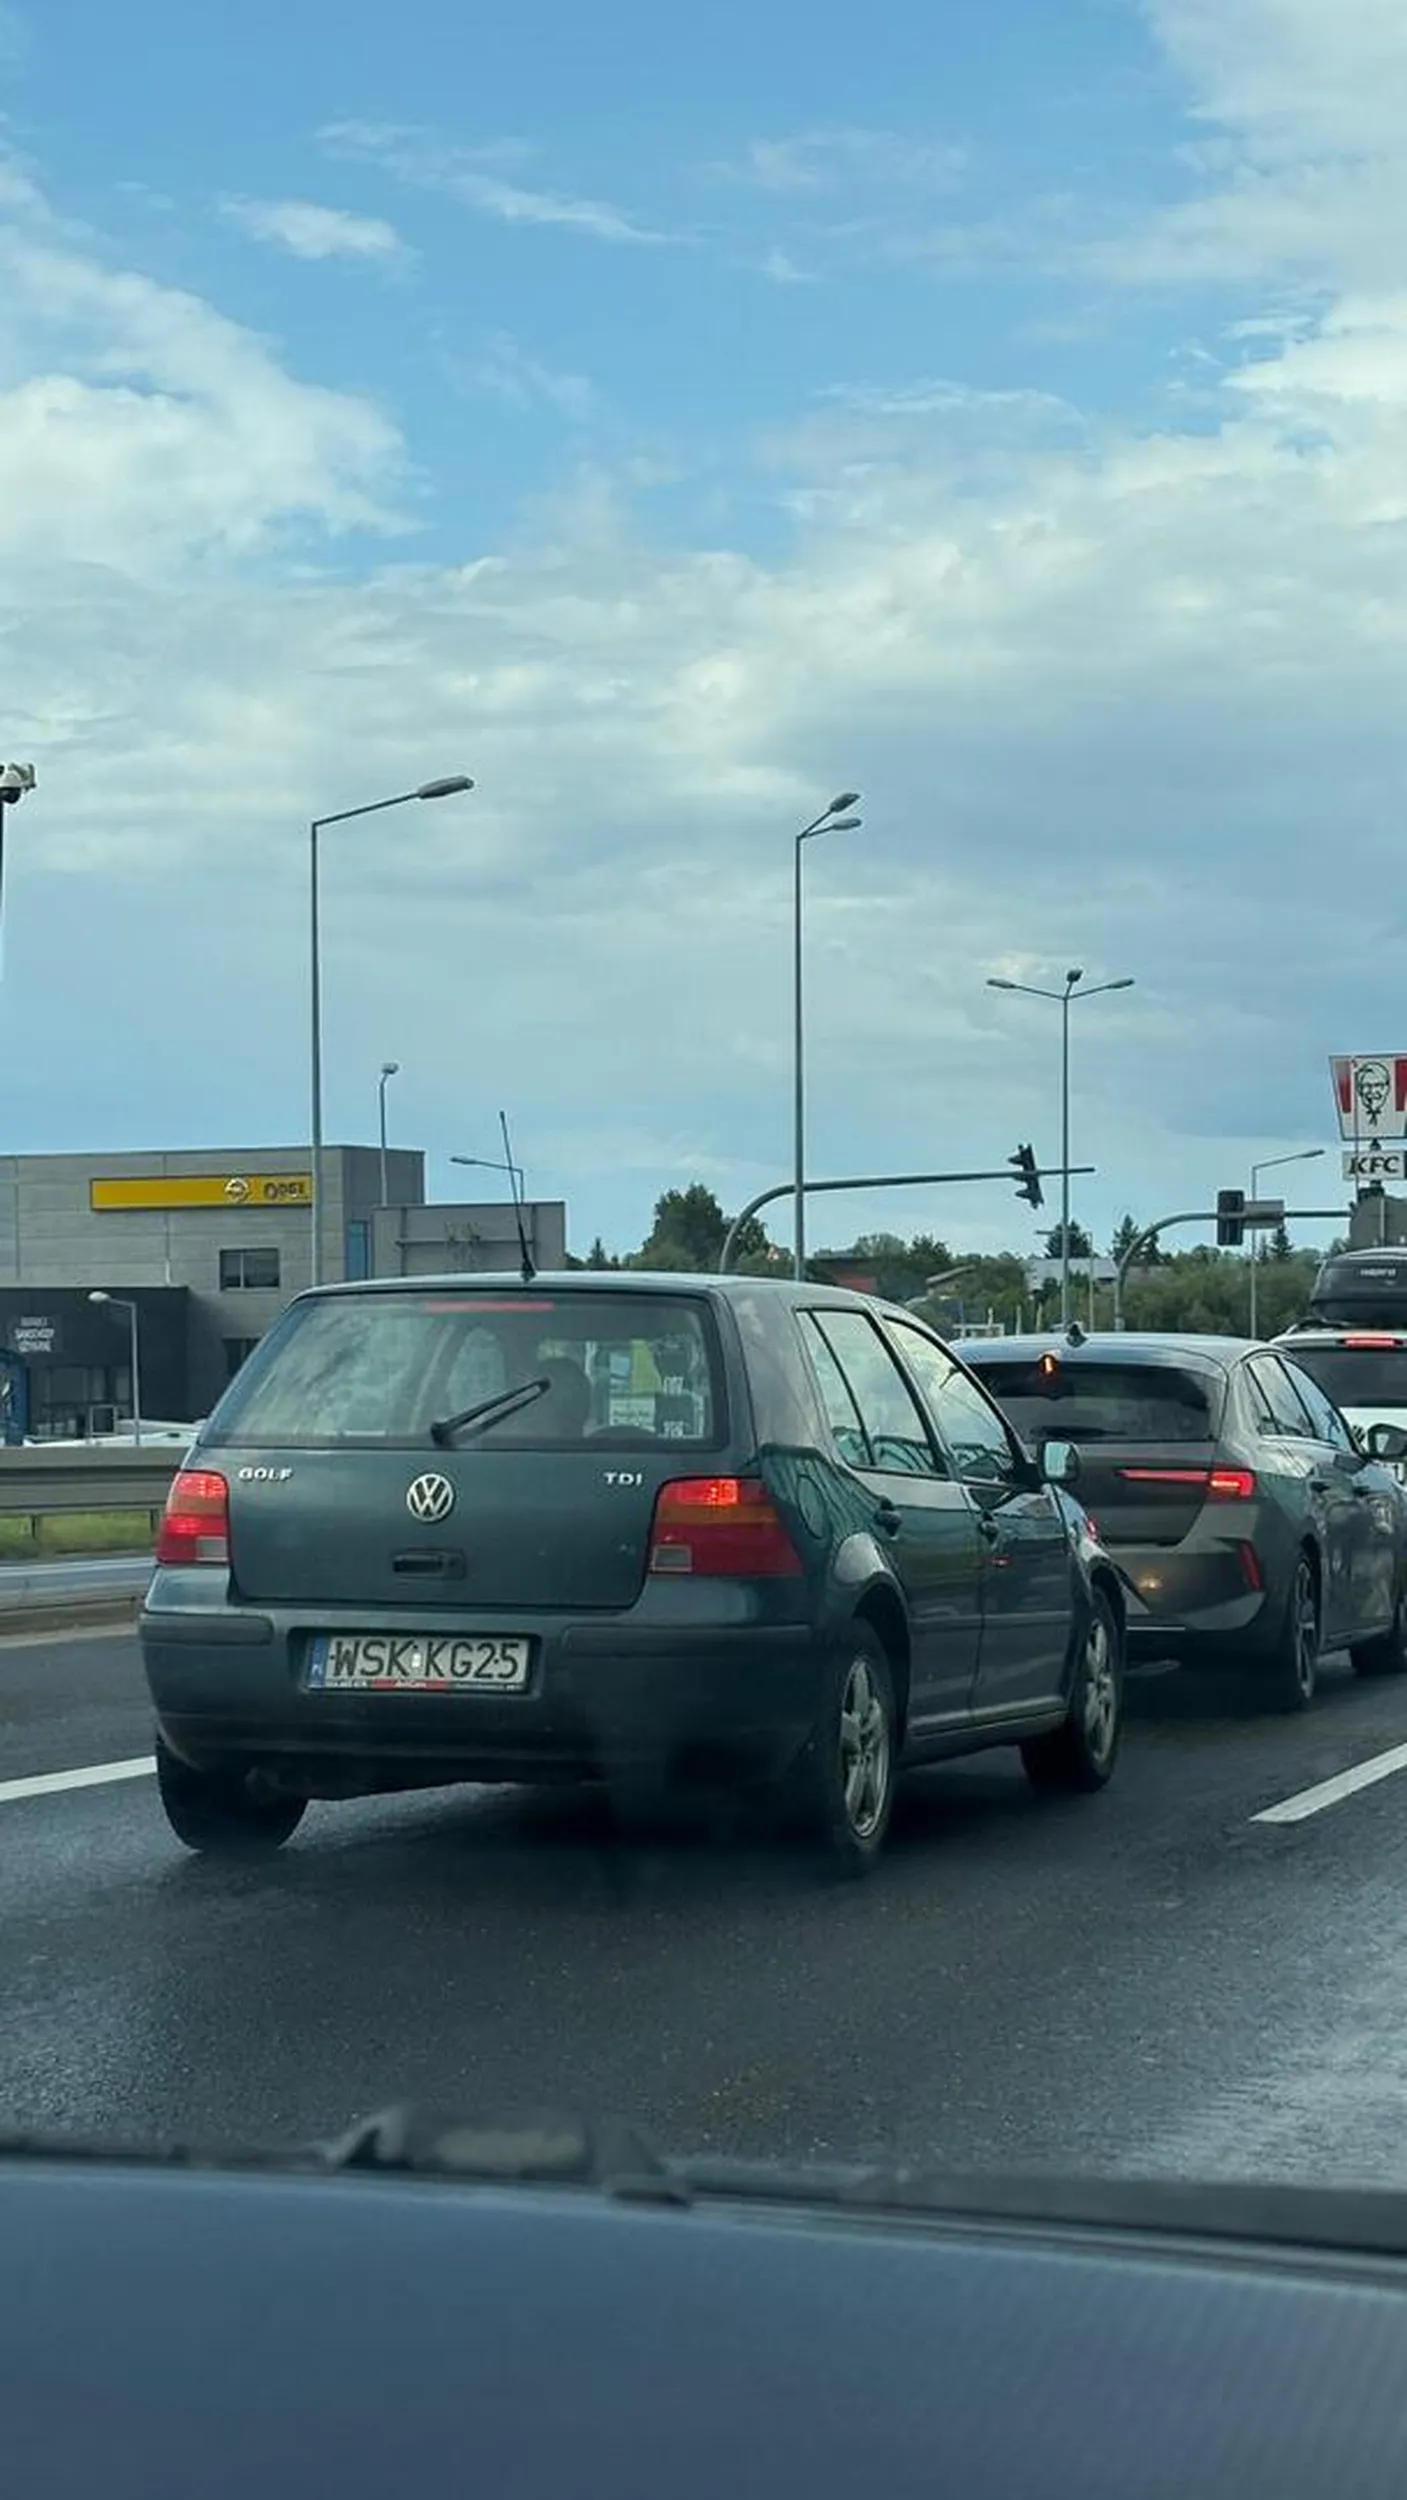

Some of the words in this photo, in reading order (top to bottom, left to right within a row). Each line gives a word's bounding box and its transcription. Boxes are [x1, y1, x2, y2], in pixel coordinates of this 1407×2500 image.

[1348, 1156, 1400, 1174] KFC
[239, 1466, 293, 1481] GOLF
[603, 1472, 642, 1486] TDI
[333, 1640, 414, 1677] WSK
[424, 1641, 520, 1679] KG25
